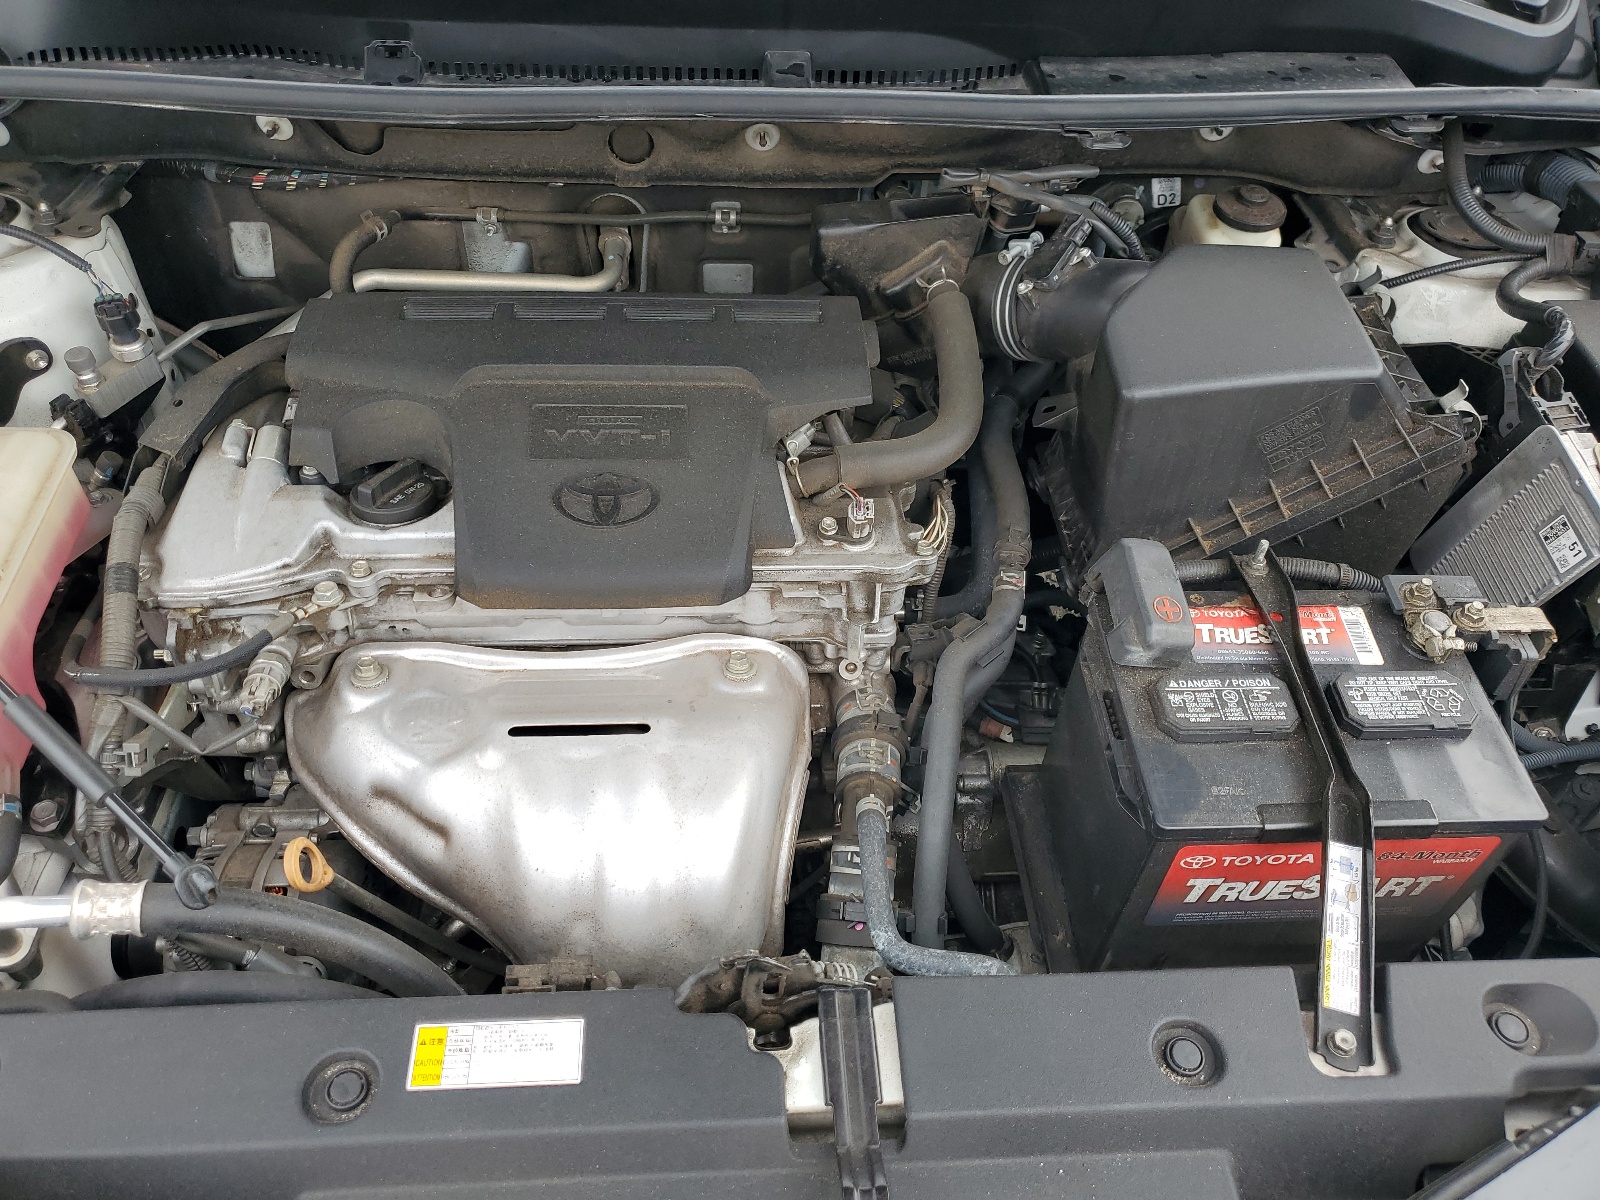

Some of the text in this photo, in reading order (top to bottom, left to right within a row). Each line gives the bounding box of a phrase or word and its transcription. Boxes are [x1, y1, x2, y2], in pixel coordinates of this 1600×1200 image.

[1157, 193, 1176, 206] D2
[1568, 541, 1582, 558] 51
[1202, 609, 1249, 618] TOYOTA
[1179, 679, 1222, 688] DANGER
[1232, 678, 1271, 687] POISON
[1376, 848, 1484, 861] 84-Month
[1221, 853, 1314, 867] TOYOTA
[429, 1037, 444, 1046] 注意
[415, 1059, 443, 1067] CAUTION
[413, 1072, 441, 1082] ATTENTION
